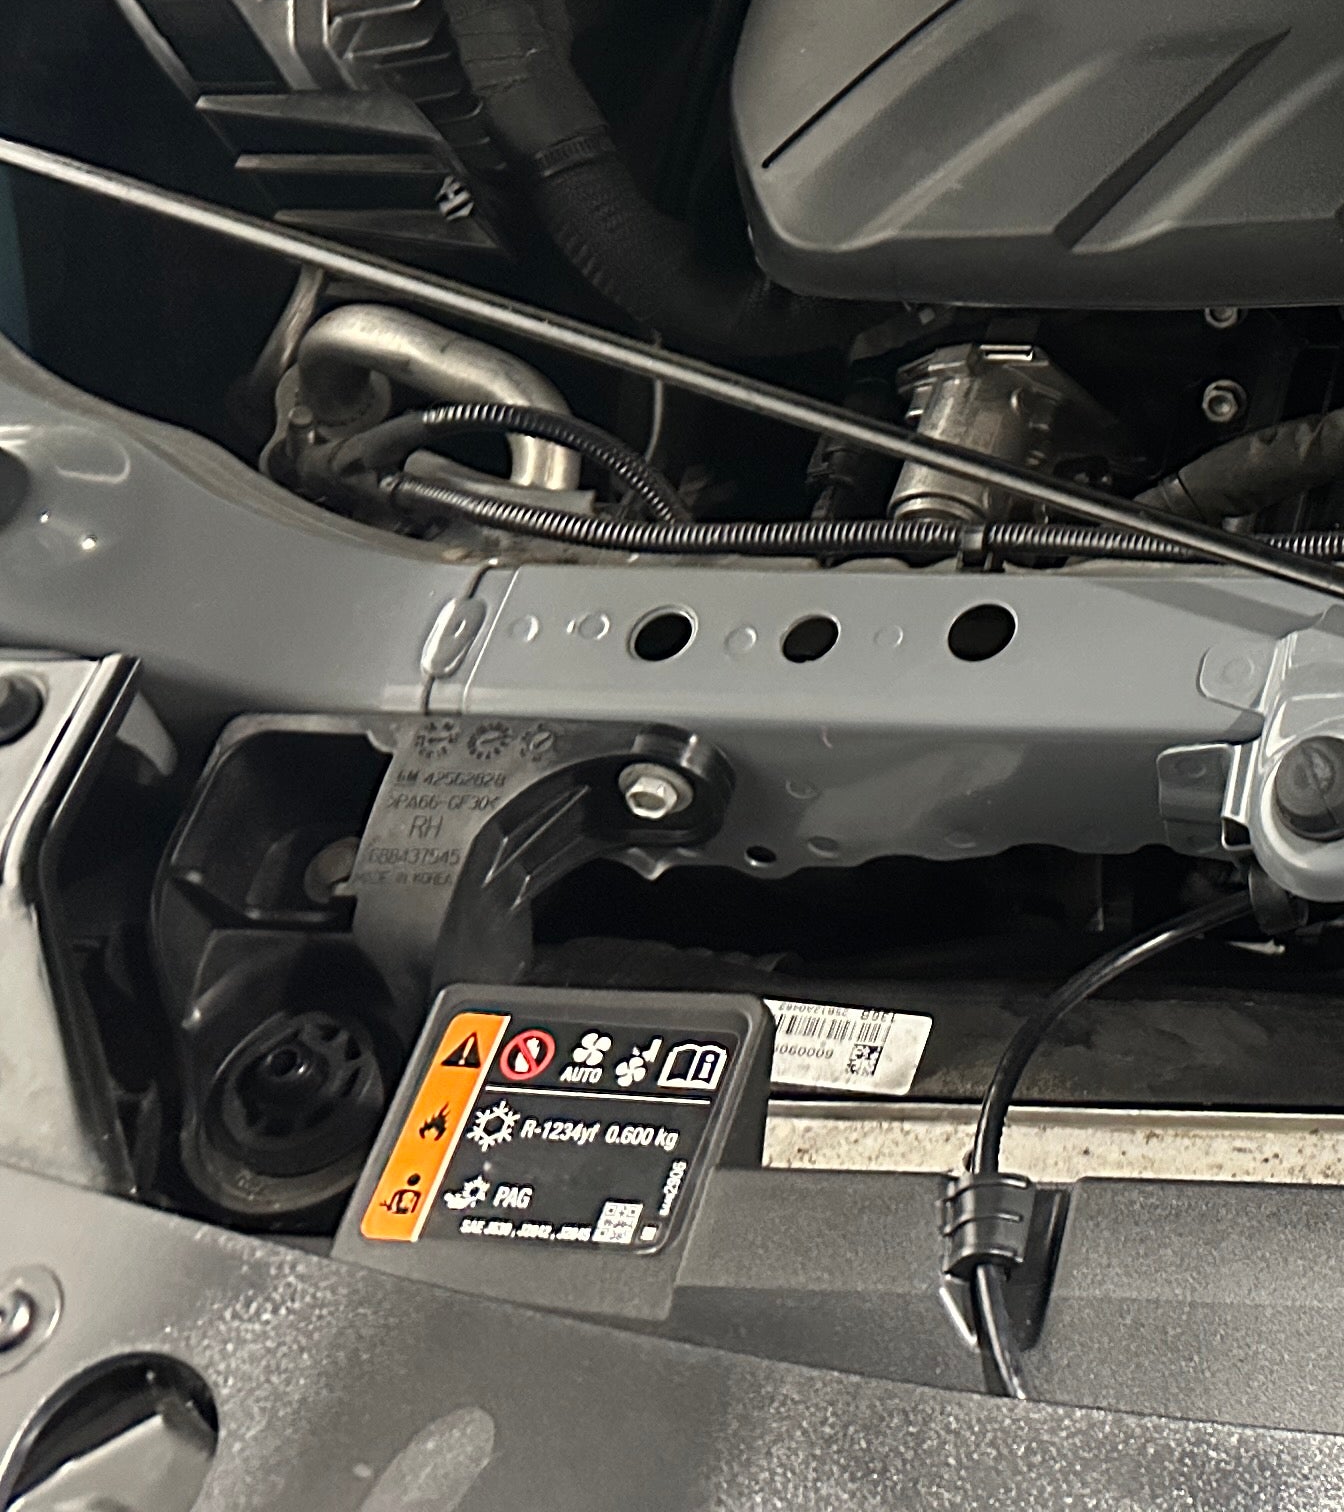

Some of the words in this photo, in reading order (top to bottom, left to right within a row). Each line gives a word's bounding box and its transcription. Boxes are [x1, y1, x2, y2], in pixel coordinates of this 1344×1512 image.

[409, 815, 444, 838] RH
[559, 1067, 603, 1084] AUTO
[520, 1119, 600, 1146] R-1234yf
[605, 1124, 655, 1146] 0.600
[655, 1127, 679, 1152] kg
[493, 1186, 534, 1209] PAG
[459, 1219, 486, 1234] SAE
